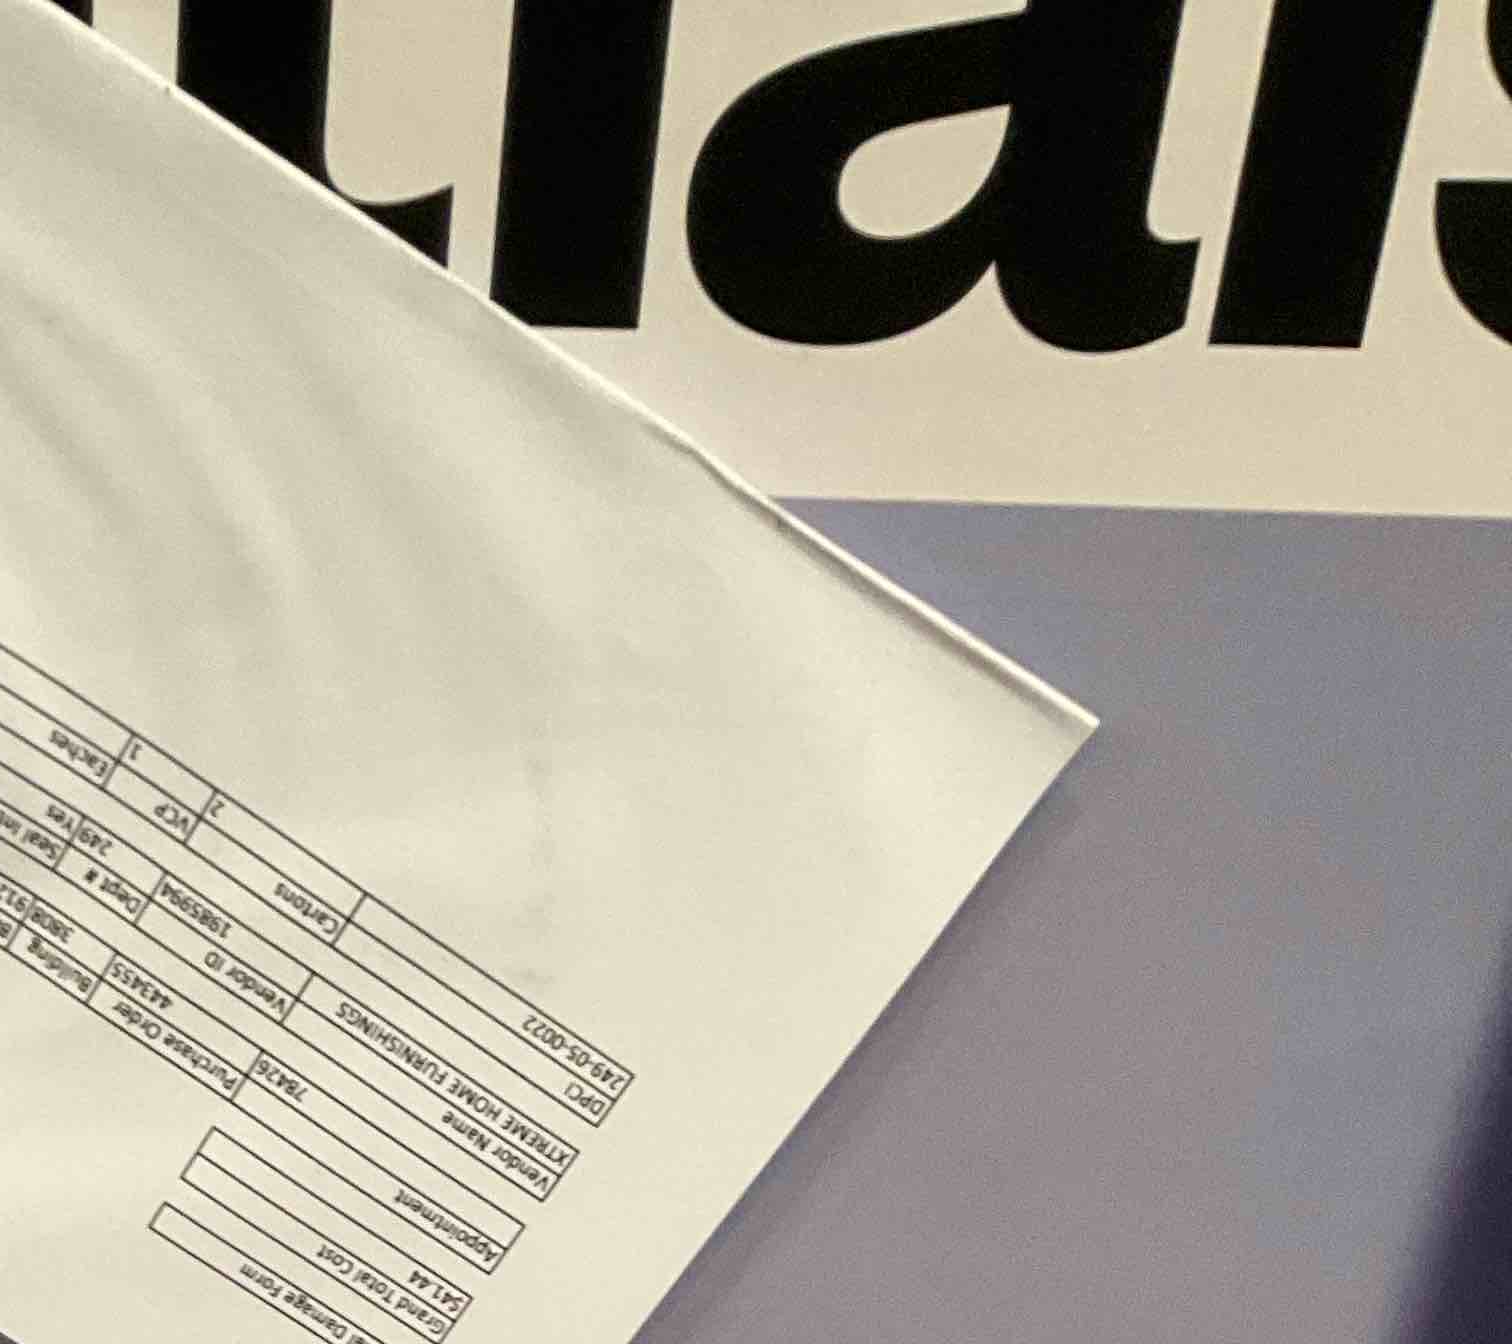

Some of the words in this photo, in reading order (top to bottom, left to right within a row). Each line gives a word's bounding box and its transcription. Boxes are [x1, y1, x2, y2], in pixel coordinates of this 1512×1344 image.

[44, 728, 109, 779] Eaches
[41, 802, 76, 833] Yes
[151, 798, 192, 833] VCP
[19, 826, 61, 861] Seal
[76, 824, 114, 857] 249
[96, 873, 144, 914] Dept
[156, 880, 234, 939] 1985994
[269, 880, 343, 937] Cartons
[26, 904, 76, 945] 3808
[22, 935, 97, 994] Building
[200, 947, 227, 973] ID
[107, 960, 176, 1012] 443455
[221, 962, 290, 1015] Vendor
[109, 997, 164, 1041] Order
[158, 1030, 240, 1092] Purchase
[331, 999, 451, 1086] FURNISHINGS
[518, 1012, 627, 1092] 249-05-0022
[252, 1058, 309, 1103] 78426
[445, 1077, 504, 1123] HOME
[562, 1080, 605, 1116] DPCI
[438, 1109, 492, 1152] Name
[499, 1113, 571, 1168] XTREME
[488, 1142, 552, 1192] Vendor
[391, 1186, 500, 1265] Appointment
[237, 1261, 284, 1298] Form
[314, 1243, 355, 1277] Cost
[352, 1268, 396, 1304] Total
[405, 1267, 465, 1314] $41.44
[281, 1287, 351, 1341] Damage
[393, 1294, 448, 1337] Grand
